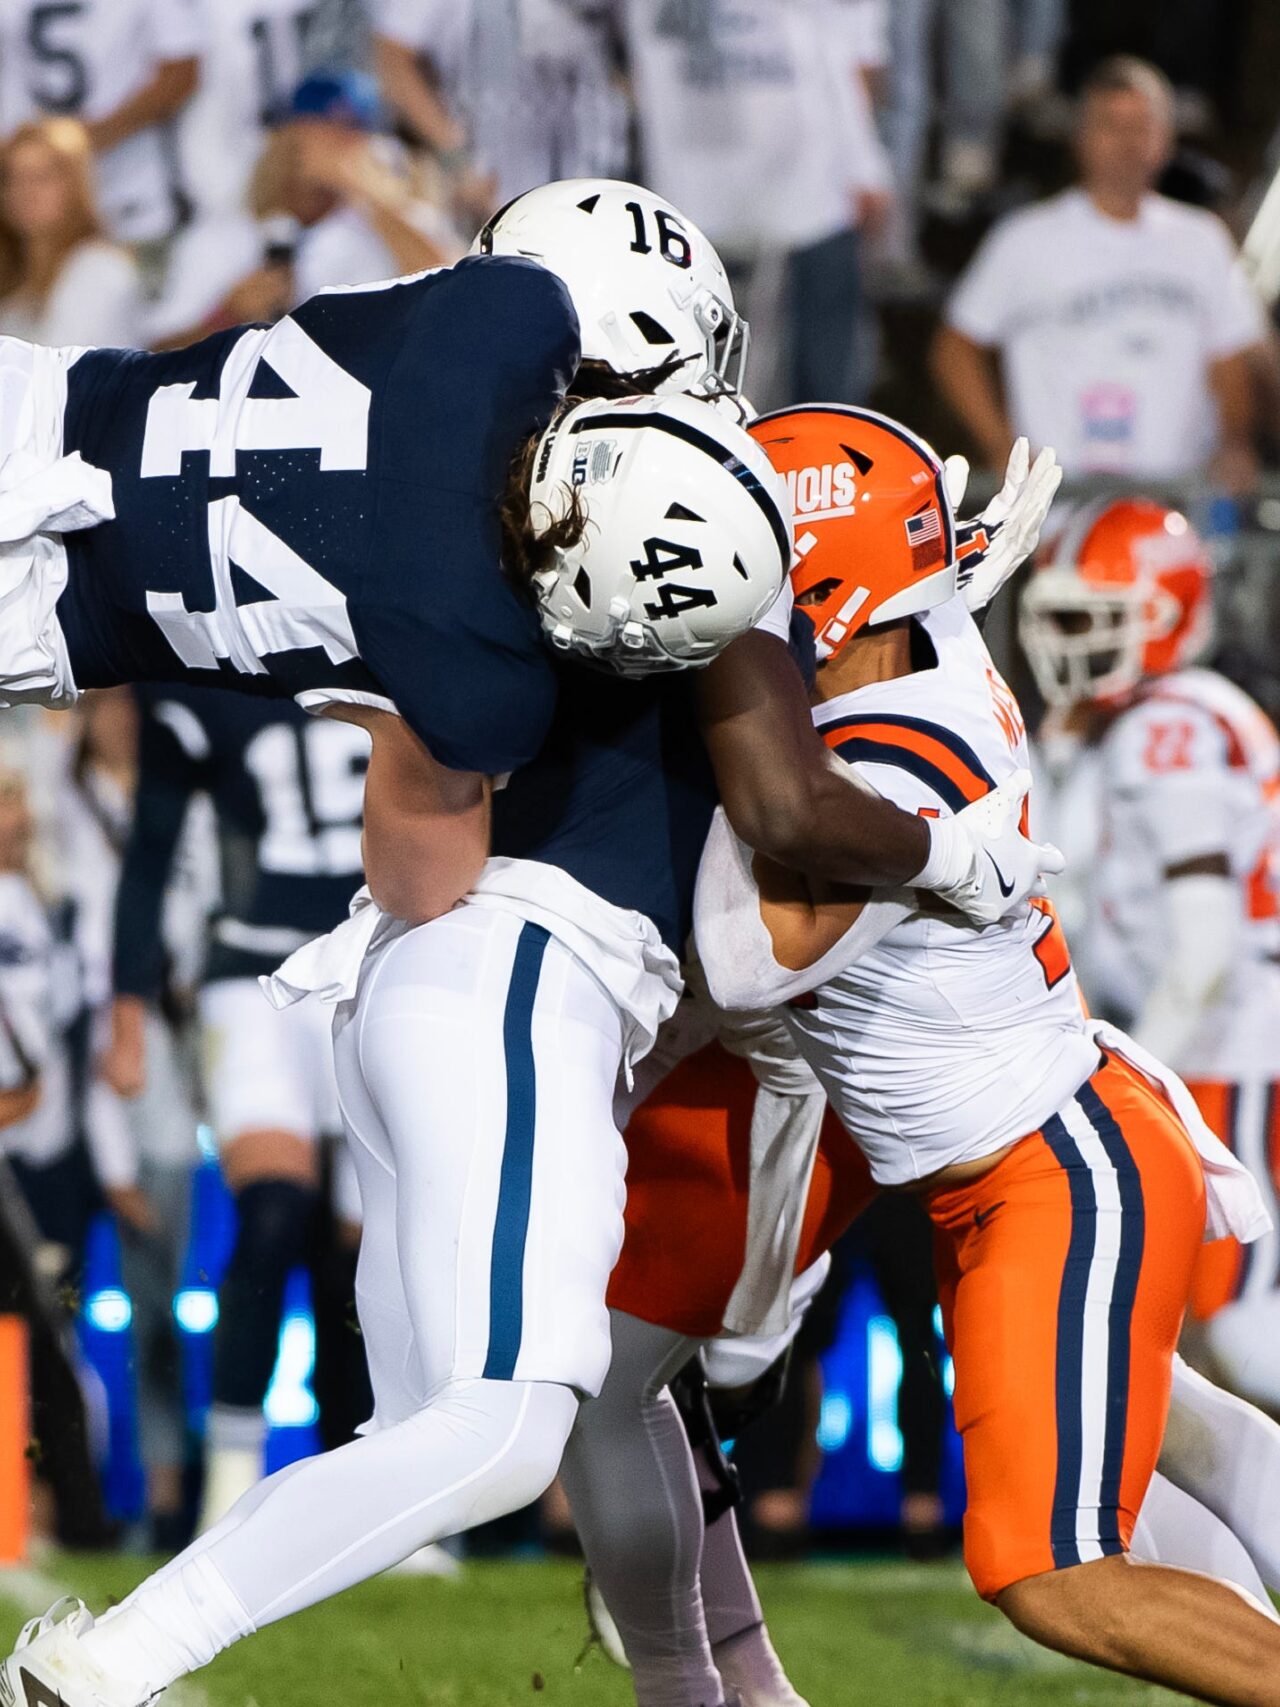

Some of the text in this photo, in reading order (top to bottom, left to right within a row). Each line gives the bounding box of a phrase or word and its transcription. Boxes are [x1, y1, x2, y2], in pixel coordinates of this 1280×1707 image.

[26, 1, 88, 116] 5
[625, 201, 692, 270] 16
[140, 314, 373, 676] 44
[629, 536, 719, 622] 44
